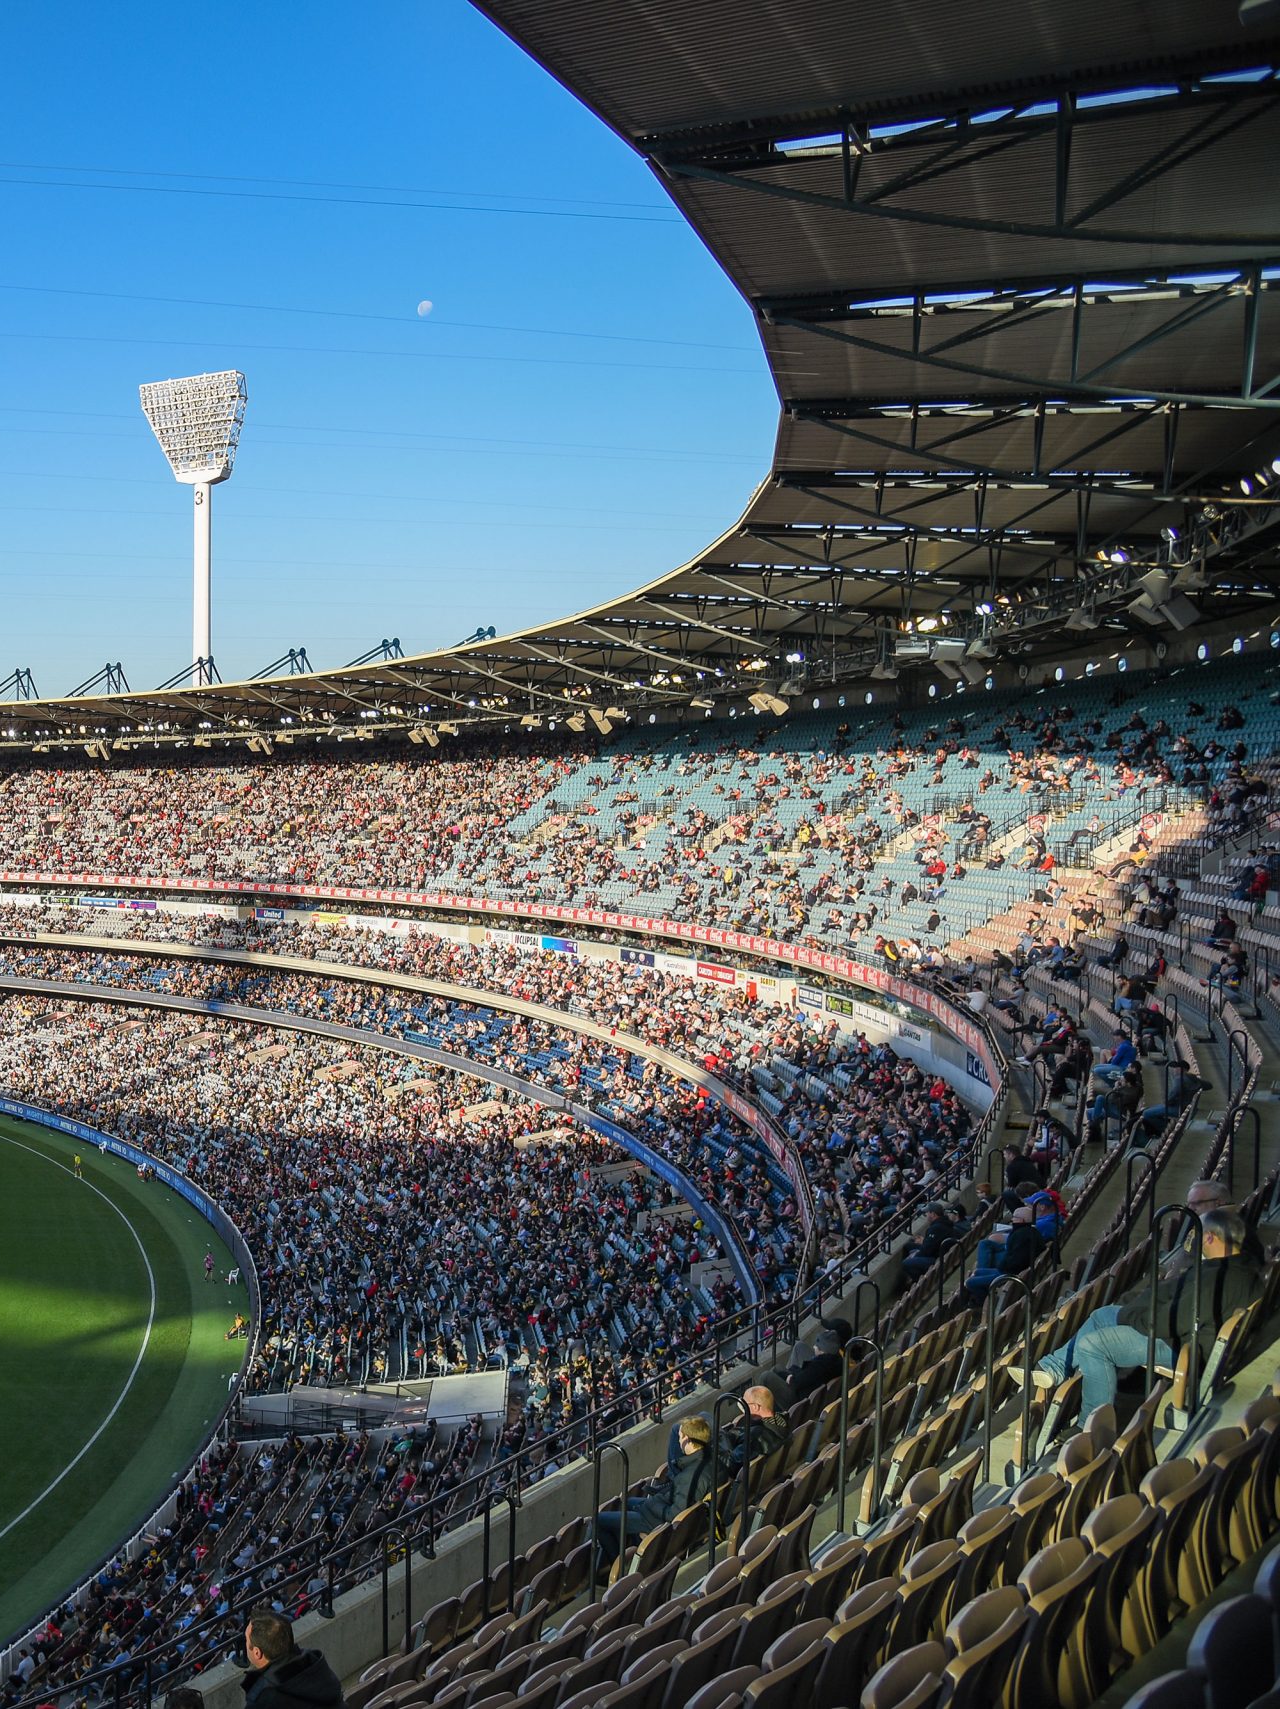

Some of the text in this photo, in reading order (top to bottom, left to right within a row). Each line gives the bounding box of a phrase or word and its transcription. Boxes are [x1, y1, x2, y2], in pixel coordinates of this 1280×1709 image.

[195, 491, 203, 505] 3
[264, 910, 282, 918] United
[409, 923, 423, 932] BOC
[519, 935, 539, 946] CLIPSAL
[903, 1028, 921, 1042] QANTAS
[18, 1106, 24, 1114] 10
